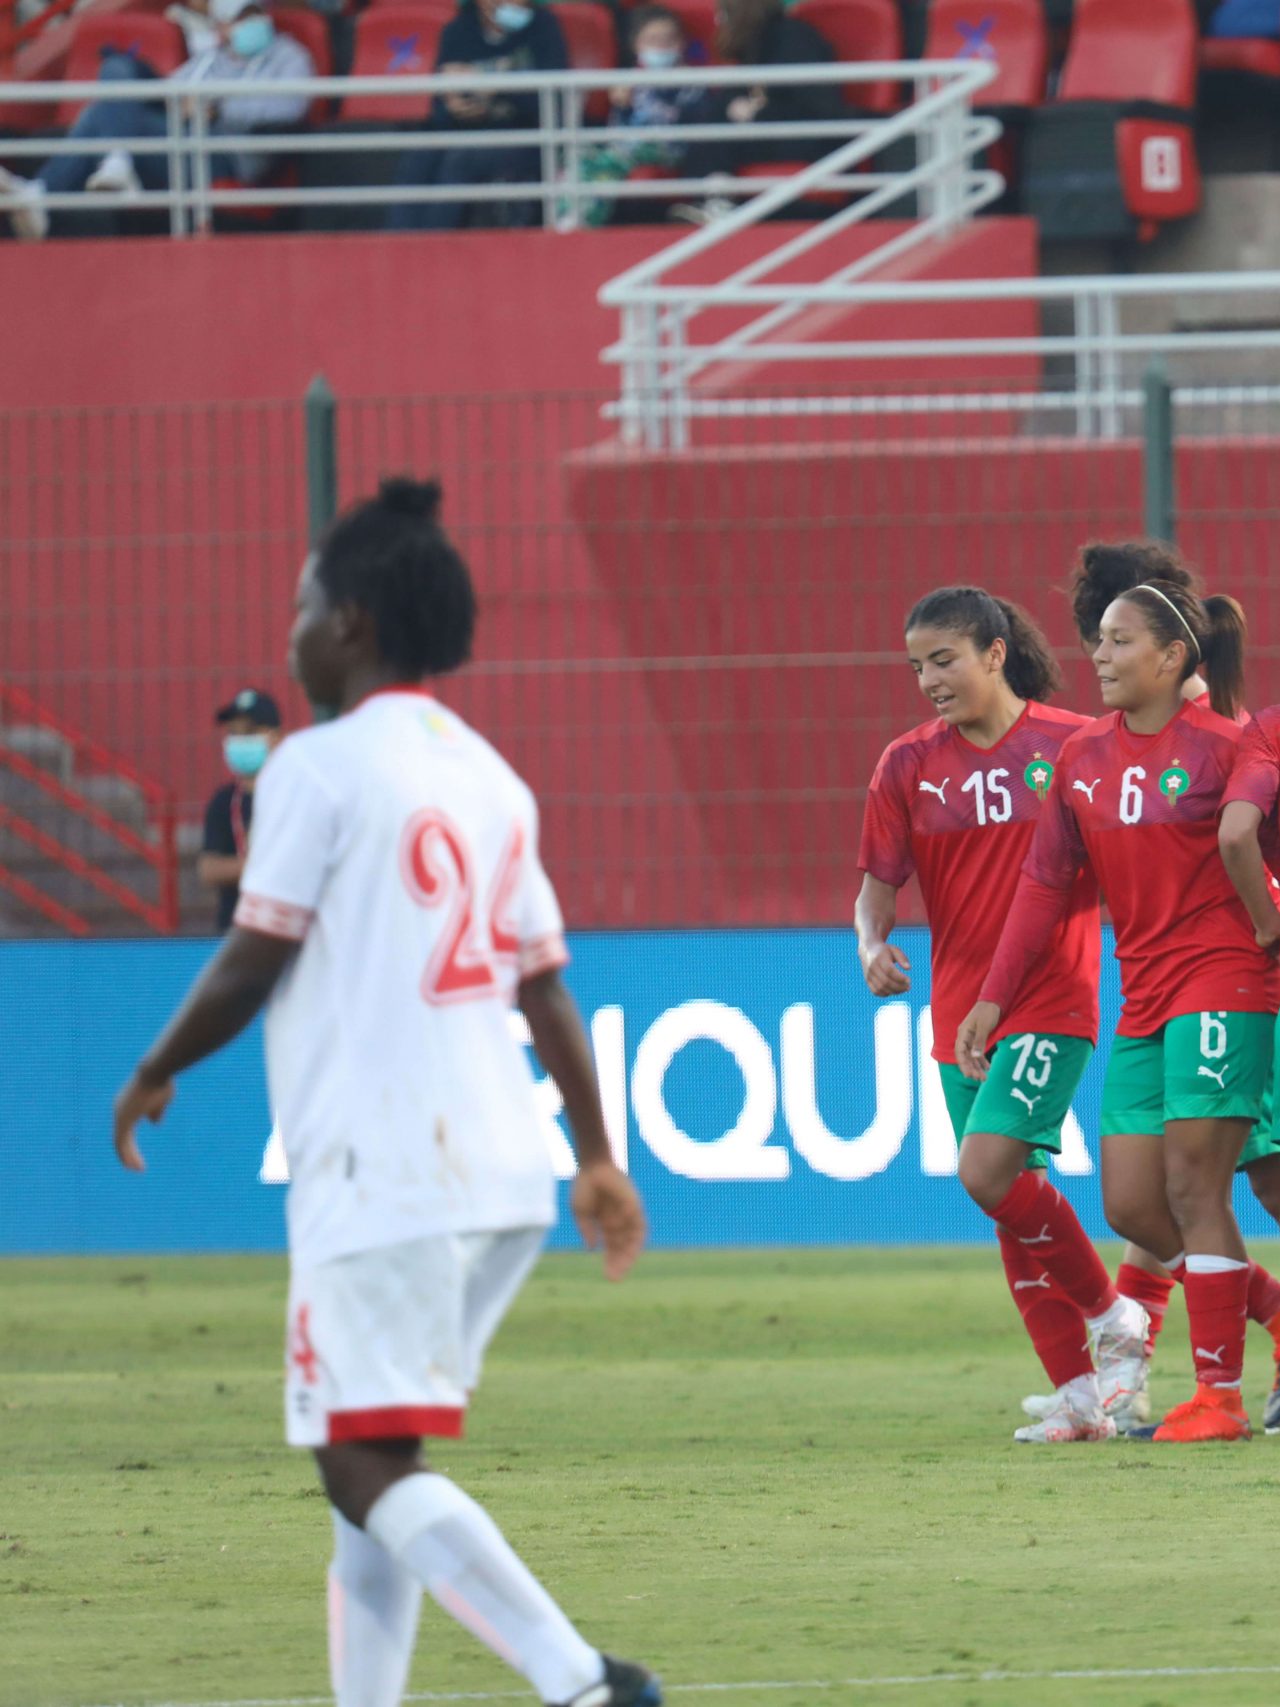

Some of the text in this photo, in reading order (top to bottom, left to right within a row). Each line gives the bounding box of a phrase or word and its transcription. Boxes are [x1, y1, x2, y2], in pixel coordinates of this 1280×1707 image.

[961, 768, 1012, 826] 15
[1119, 766, 1146, 824] 6
[1010, 1033, 1058, 1087] 15
[1200, 1011, 1227, 1058] 6
